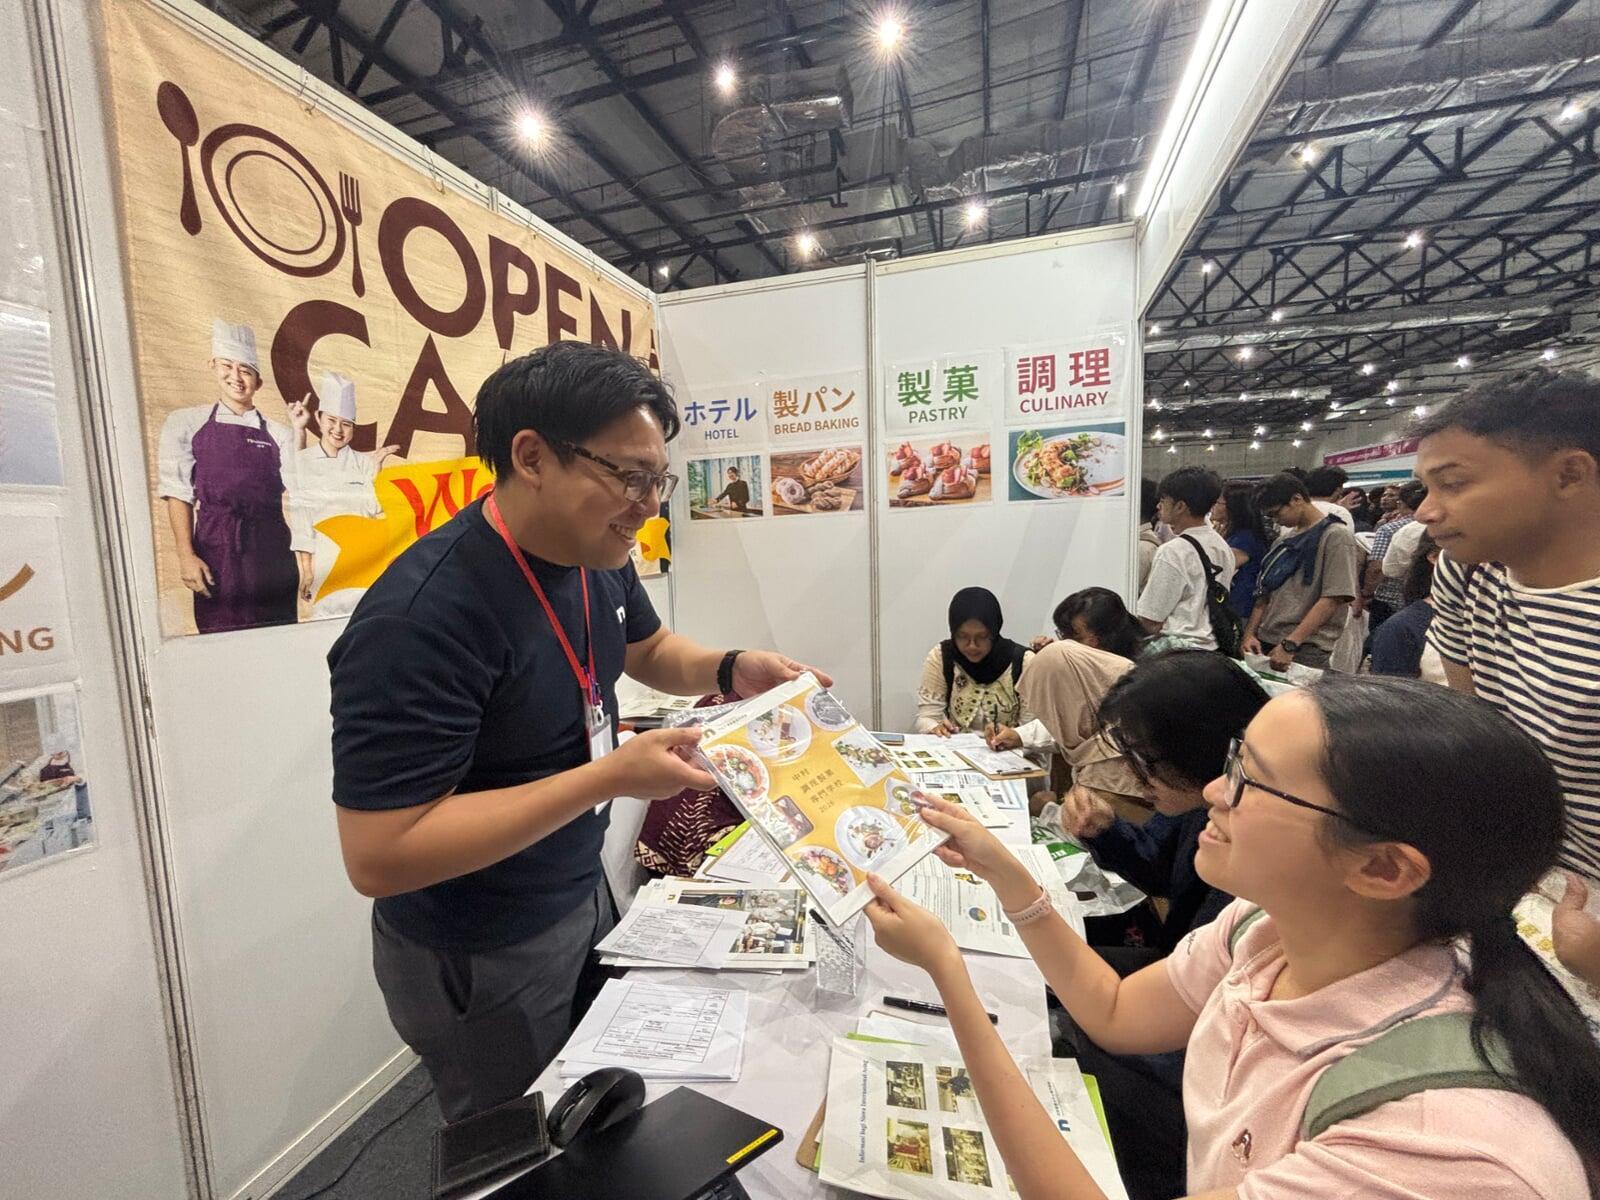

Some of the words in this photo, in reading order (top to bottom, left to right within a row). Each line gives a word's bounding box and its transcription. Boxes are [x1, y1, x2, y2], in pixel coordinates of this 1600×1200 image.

[377, 197, 632, 352] OPEN
[271, 299, 479, 460] CA
[897, 364, 980, 407] 製菓
[1016, 348, 1111, 395] 調理
[684, 397, 757, 426] ホテル
[773, 386, 855, 419] 製パン
[908, 406, 968, 424] PASTRY
[1019, 391, 1109, 414] CULINARY
[704, 428, 739, 441] HOTEL
[774, 422, 812, 435] BREAD
[814, 417, 860, 431] BAKING
